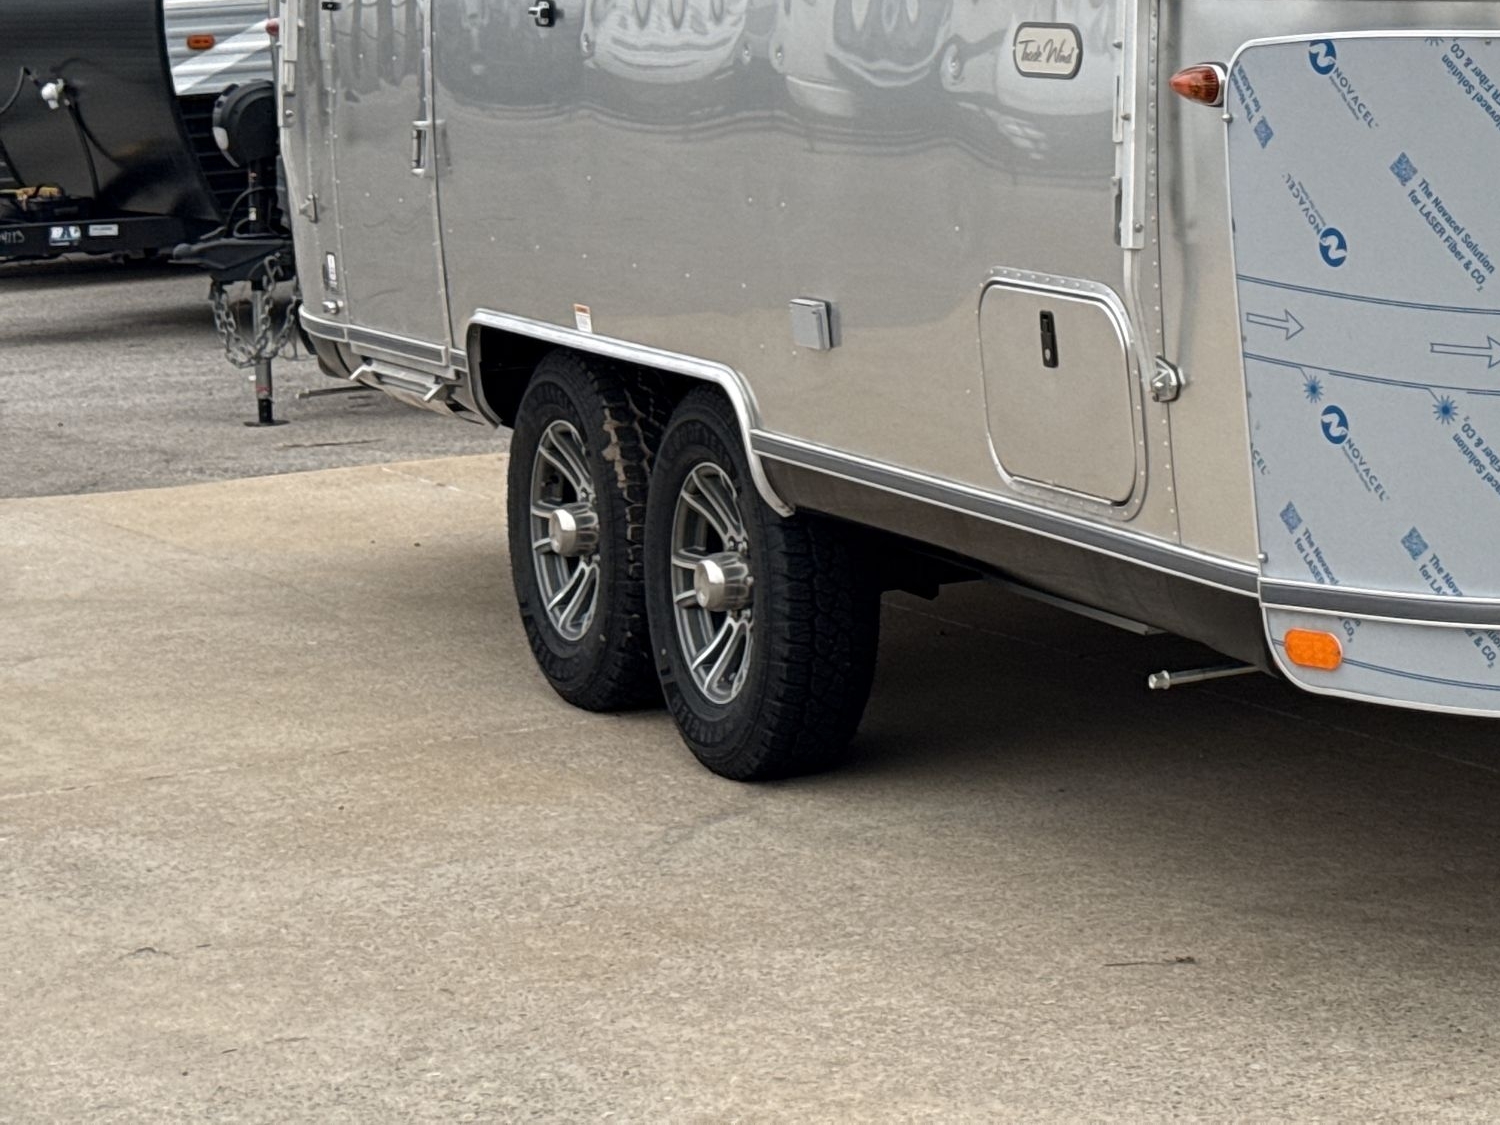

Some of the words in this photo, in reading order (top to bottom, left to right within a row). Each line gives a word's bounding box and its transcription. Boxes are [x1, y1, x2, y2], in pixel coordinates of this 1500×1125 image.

[1441, 54, 1475, 95] Solution
[1463, 57, 1473, 68] &
[1471, 66, 1494, 93] Fiber
[1333, 67, 1373, 128] NOVACEL
[1285, 173, 1322, 235] NOVACEL
[1407, 189, 1421, 206] for
[1418, 204, 1446, 239] LASER
[1443, 235, 1466, 261] Fiber
[1463, 260, 1473, 272] &
[1418, 178, 1433, 199] The
[1433, 196, 1464, 236] Novacel
[1461, 232, 1496, 274] Solution
[1452, 433, 1486, 474] Solution
[1474, 437, 1484, 448] &
[1346, 438, 1385, 502] NOVACEL
[1294, 537, 1306, 554] for
[1301, 527, 1315, 550] The
[1418, 563, 1432, 581] for
[1428, 553, 1443, 575] The
[1443, 572, 1463, 597] Nova
